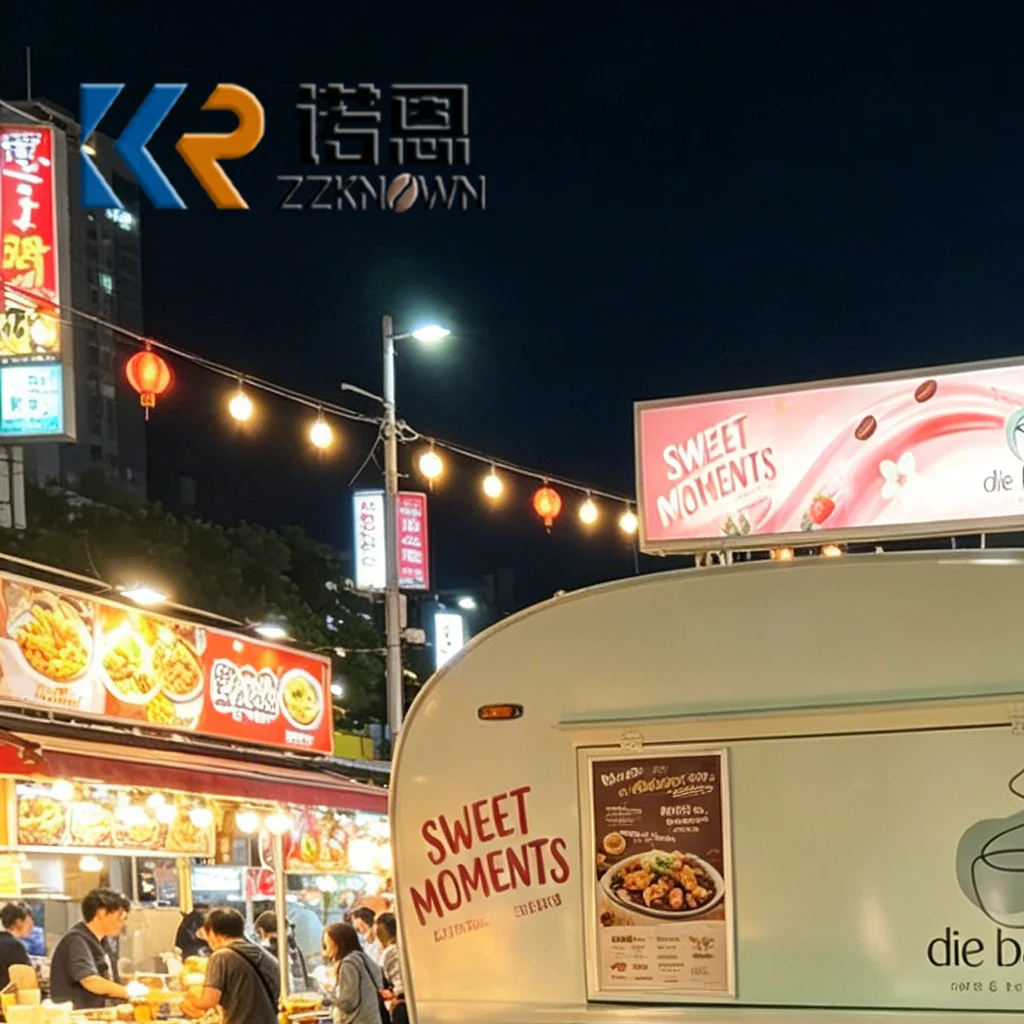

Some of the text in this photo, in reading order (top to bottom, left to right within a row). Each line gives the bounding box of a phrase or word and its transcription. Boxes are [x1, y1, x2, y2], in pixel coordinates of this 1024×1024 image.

[663, 412, 748, 480] SWEET
[983, 469, 1013, 493] die
[657, 447, 777, 528] MOMENTS
[421, 786, 532, 865] SWEET
[409, 837, 570, 926] MOMENTS
[927, 926, 985, 968] die
